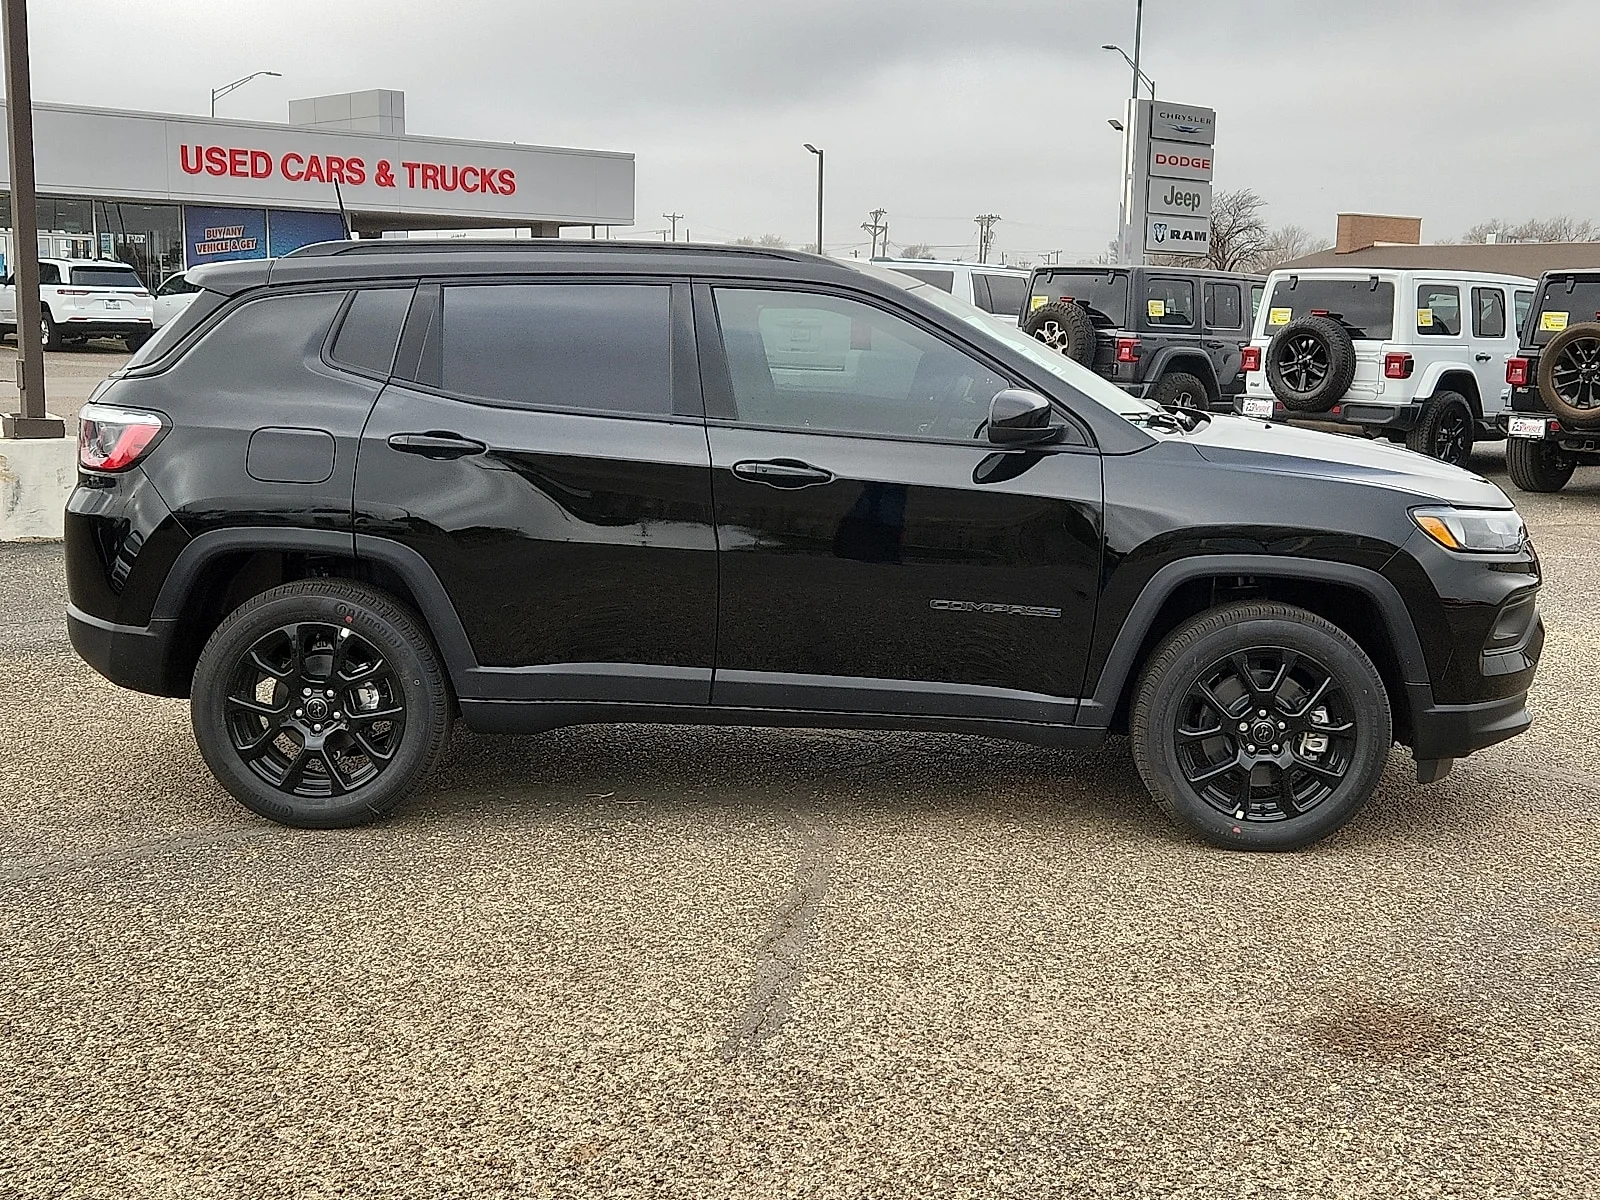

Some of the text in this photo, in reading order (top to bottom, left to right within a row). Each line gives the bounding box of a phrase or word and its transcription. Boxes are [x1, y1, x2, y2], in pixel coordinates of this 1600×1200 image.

[1159, 112, 1211, 125] CHRYSLER
[1155, 153, 1211, 170] DODGE
[180, 144, 516, 196] USED CARS & TRUCKS
[1163, 185, 1201, 212] Jeep
[206, 226, 242, 239] BUY ANY
[1170, 229, 1207, 242] RAM
[196, 239, 256, 253] VEHICLE & GET
[929, 599, 1062, 619] COMPASS
